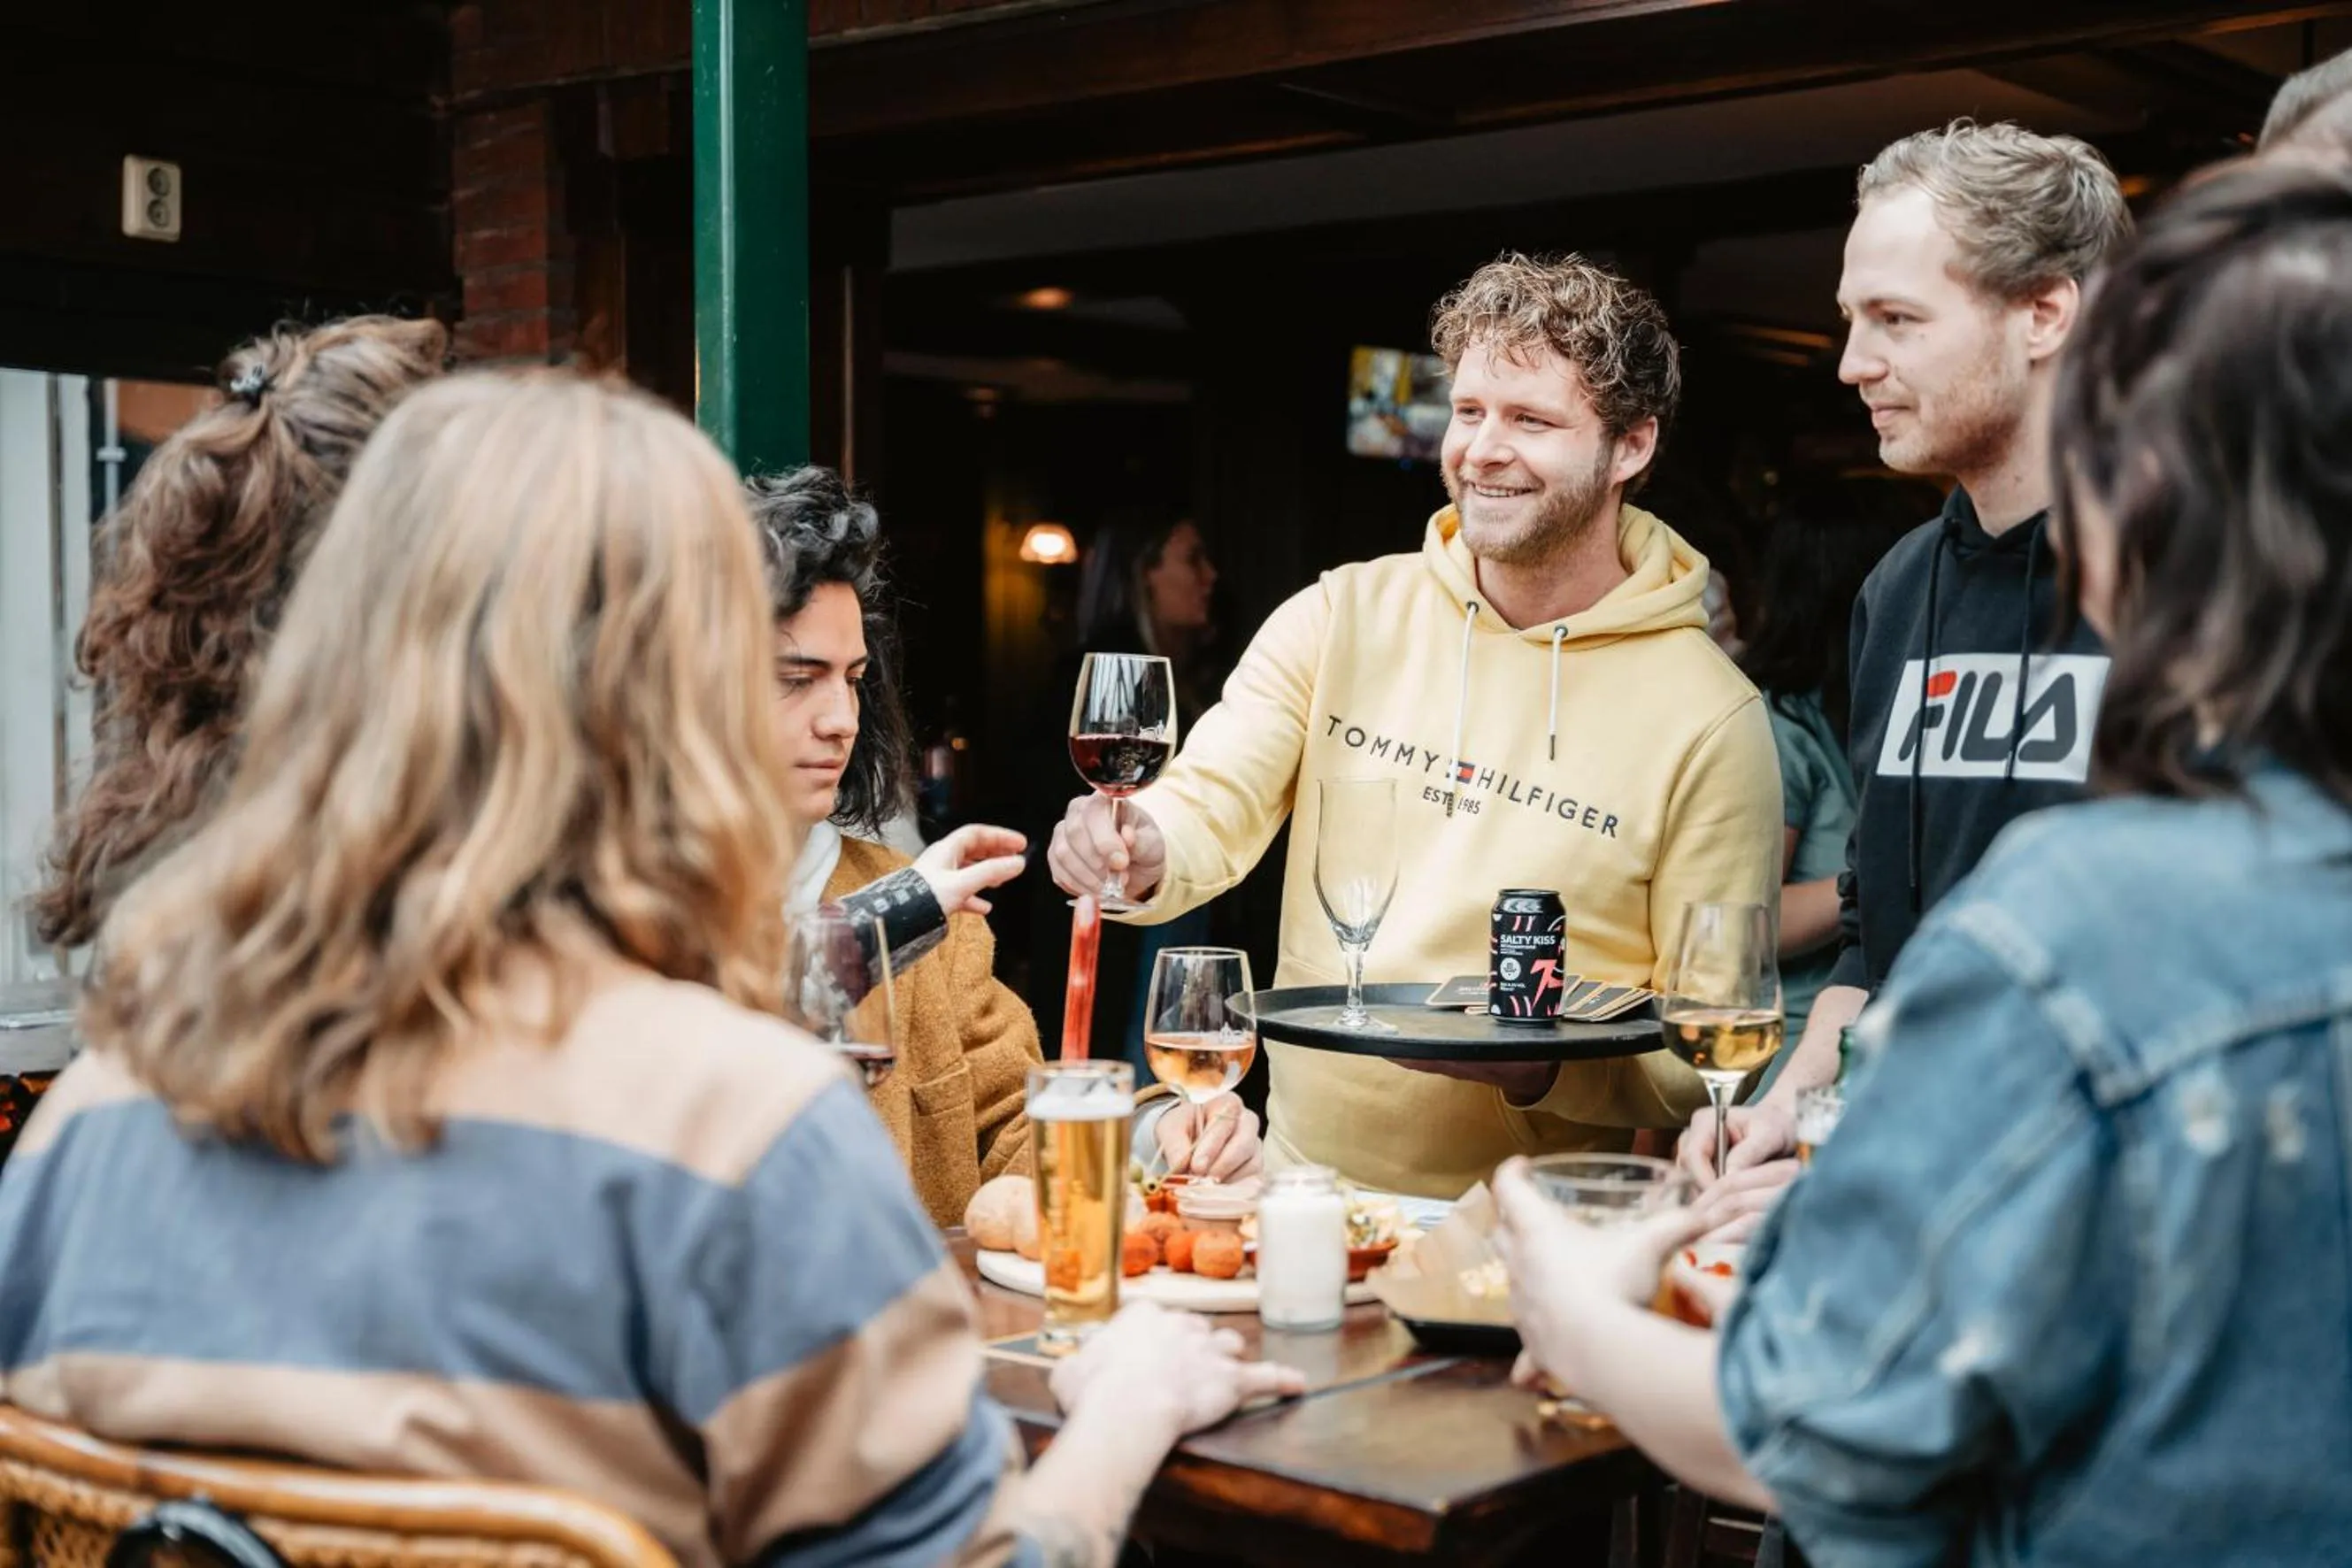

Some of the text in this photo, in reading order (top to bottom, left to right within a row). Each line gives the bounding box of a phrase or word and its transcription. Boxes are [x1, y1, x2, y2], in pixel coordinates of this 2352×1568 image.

[1898, 670, 2078, 763] FILA
[1327, 715, 1619, 839] TOMMY HILFIGER
[1457, 796, 1481, 815] 1985
[1500, 934, 1556, 946] SALTY KISS
